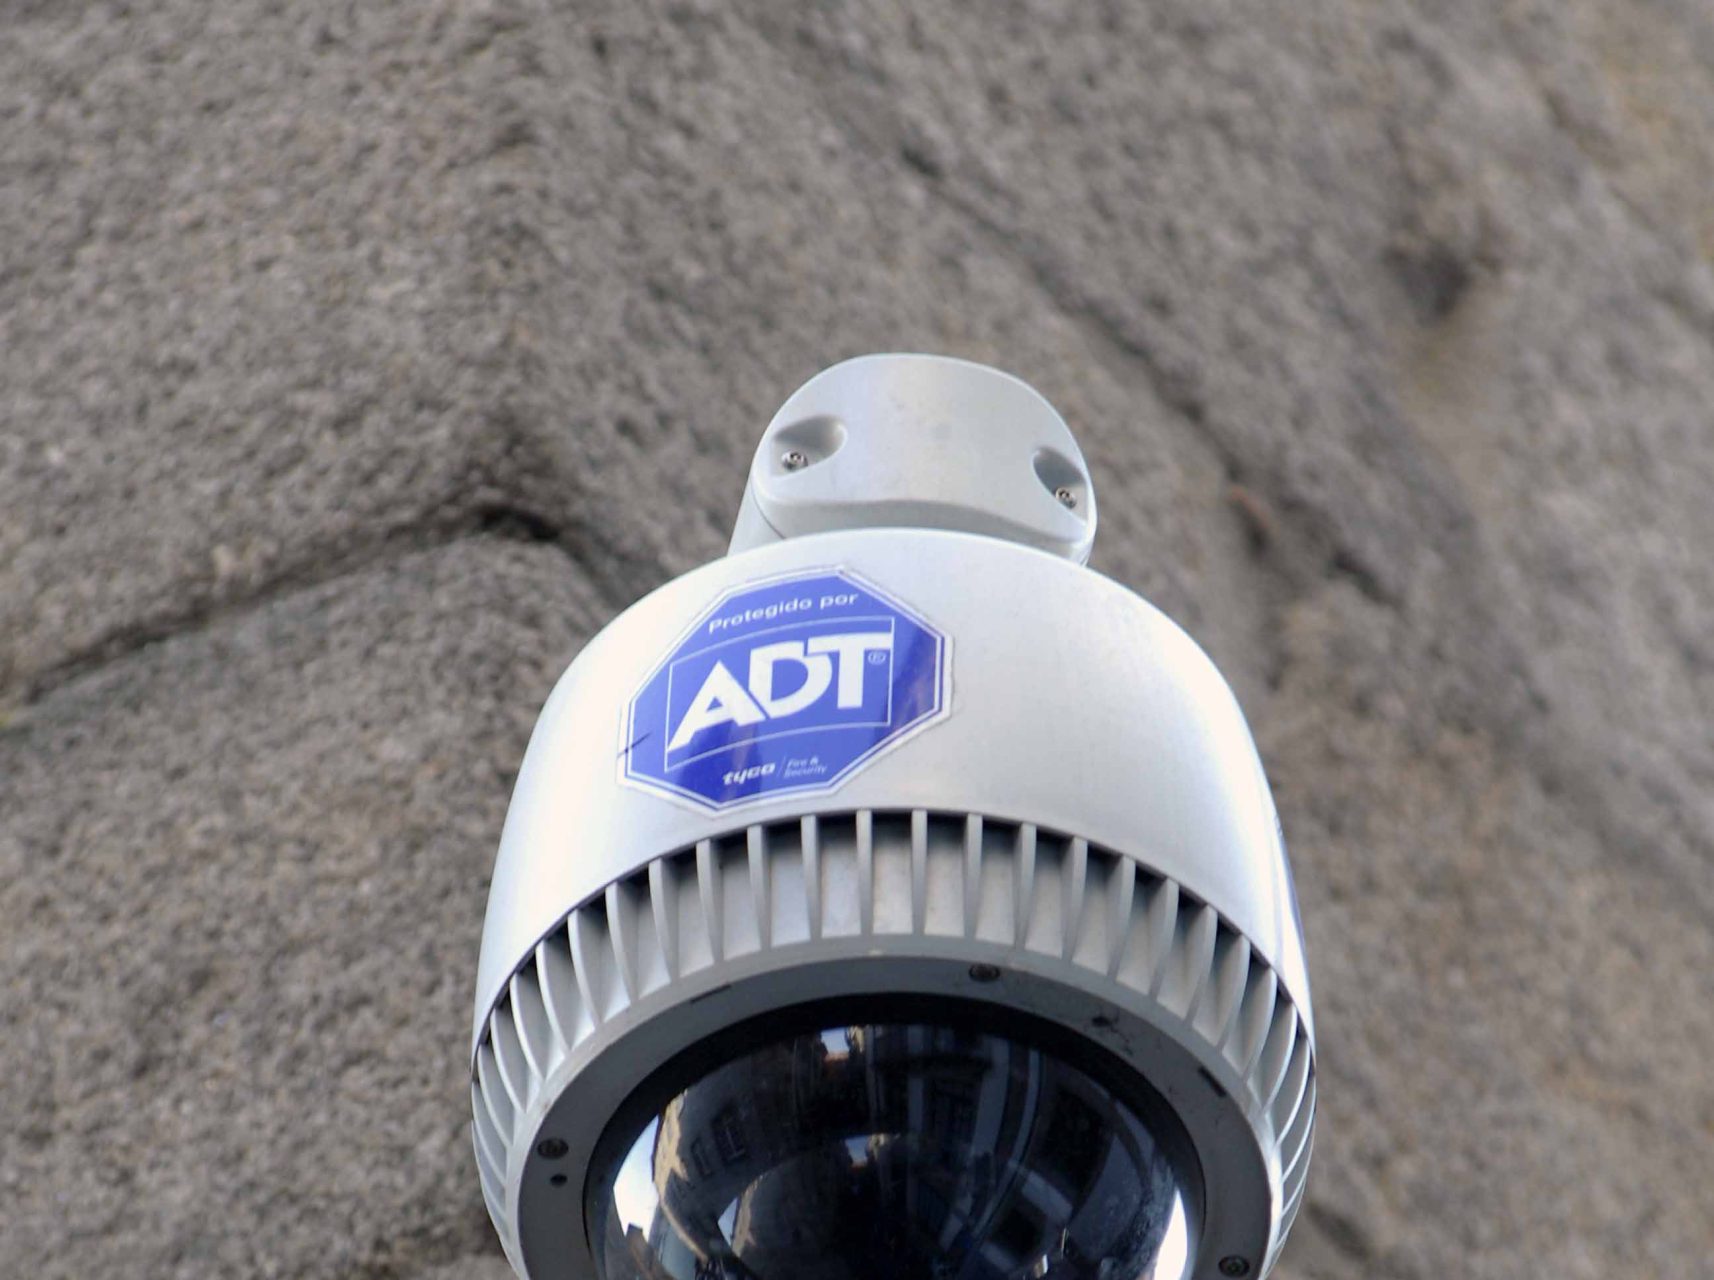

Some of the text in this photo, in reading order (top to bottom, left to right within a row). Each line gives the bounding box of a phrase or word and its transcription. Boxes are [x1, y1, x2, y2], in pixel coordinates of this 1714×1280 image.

[709, 593, 858, 634] Protegido por
[723, 762, 776, 785] tyco
